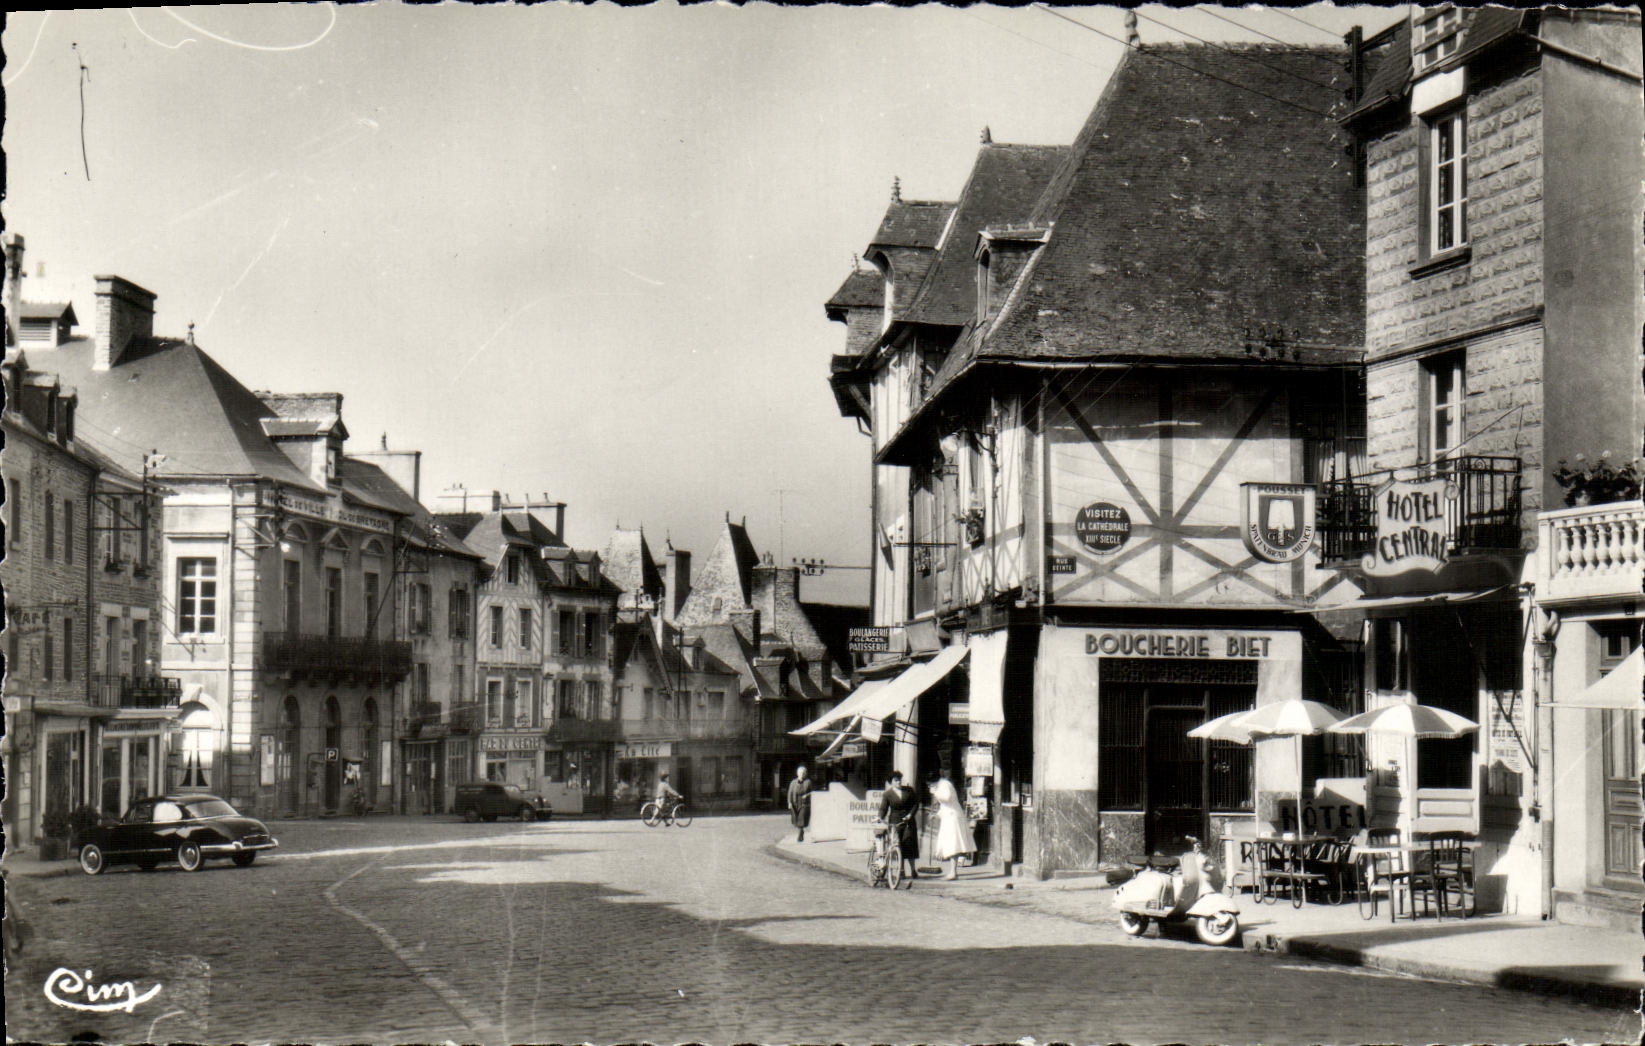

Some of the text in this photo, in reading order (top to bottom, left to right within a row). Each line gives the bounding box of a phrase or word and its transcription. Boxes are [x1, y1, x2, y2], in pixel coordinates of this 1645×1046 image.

[1257, 485, 1306, 495] POUSSET
[1085, 509, 1121, 519] VISITEZ
[1077, 521, 1129, 532] LA CATHÉDRALE
[1379, 526, 1448, 564] CENTRAL
[849, 628, 889, 638] BOULANGERIE
[848, 643, 888, 652] PATISSERIE
[1085, 633, 1272, 657] BOUCHERIE BIET
